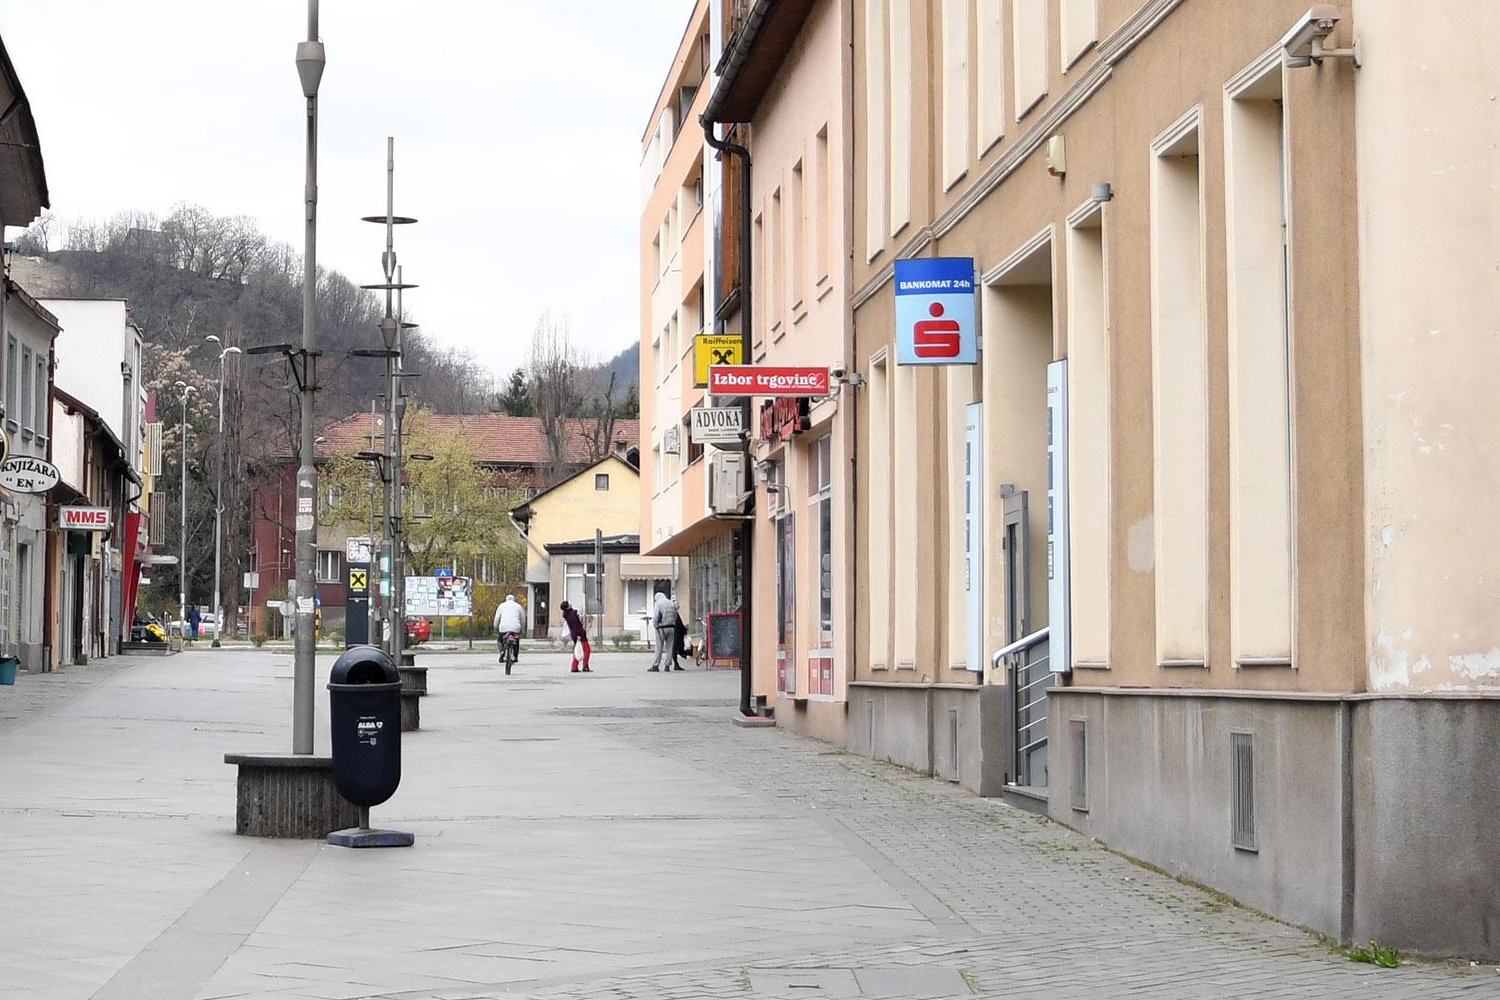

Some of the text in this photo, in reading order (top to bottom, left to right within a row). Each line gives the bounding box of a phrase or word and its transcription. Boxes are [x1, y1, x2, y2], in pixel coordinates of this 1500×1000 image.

[900, 280, 970, 289] BANKOMAT 24h
[714, 373, 817, 389] Izbor trgovine
[695, 410, 742, 428] ADVOKA
[1, 460, 57, 480] KNJIŽARA
[67, 510, 107, 524] MMS
